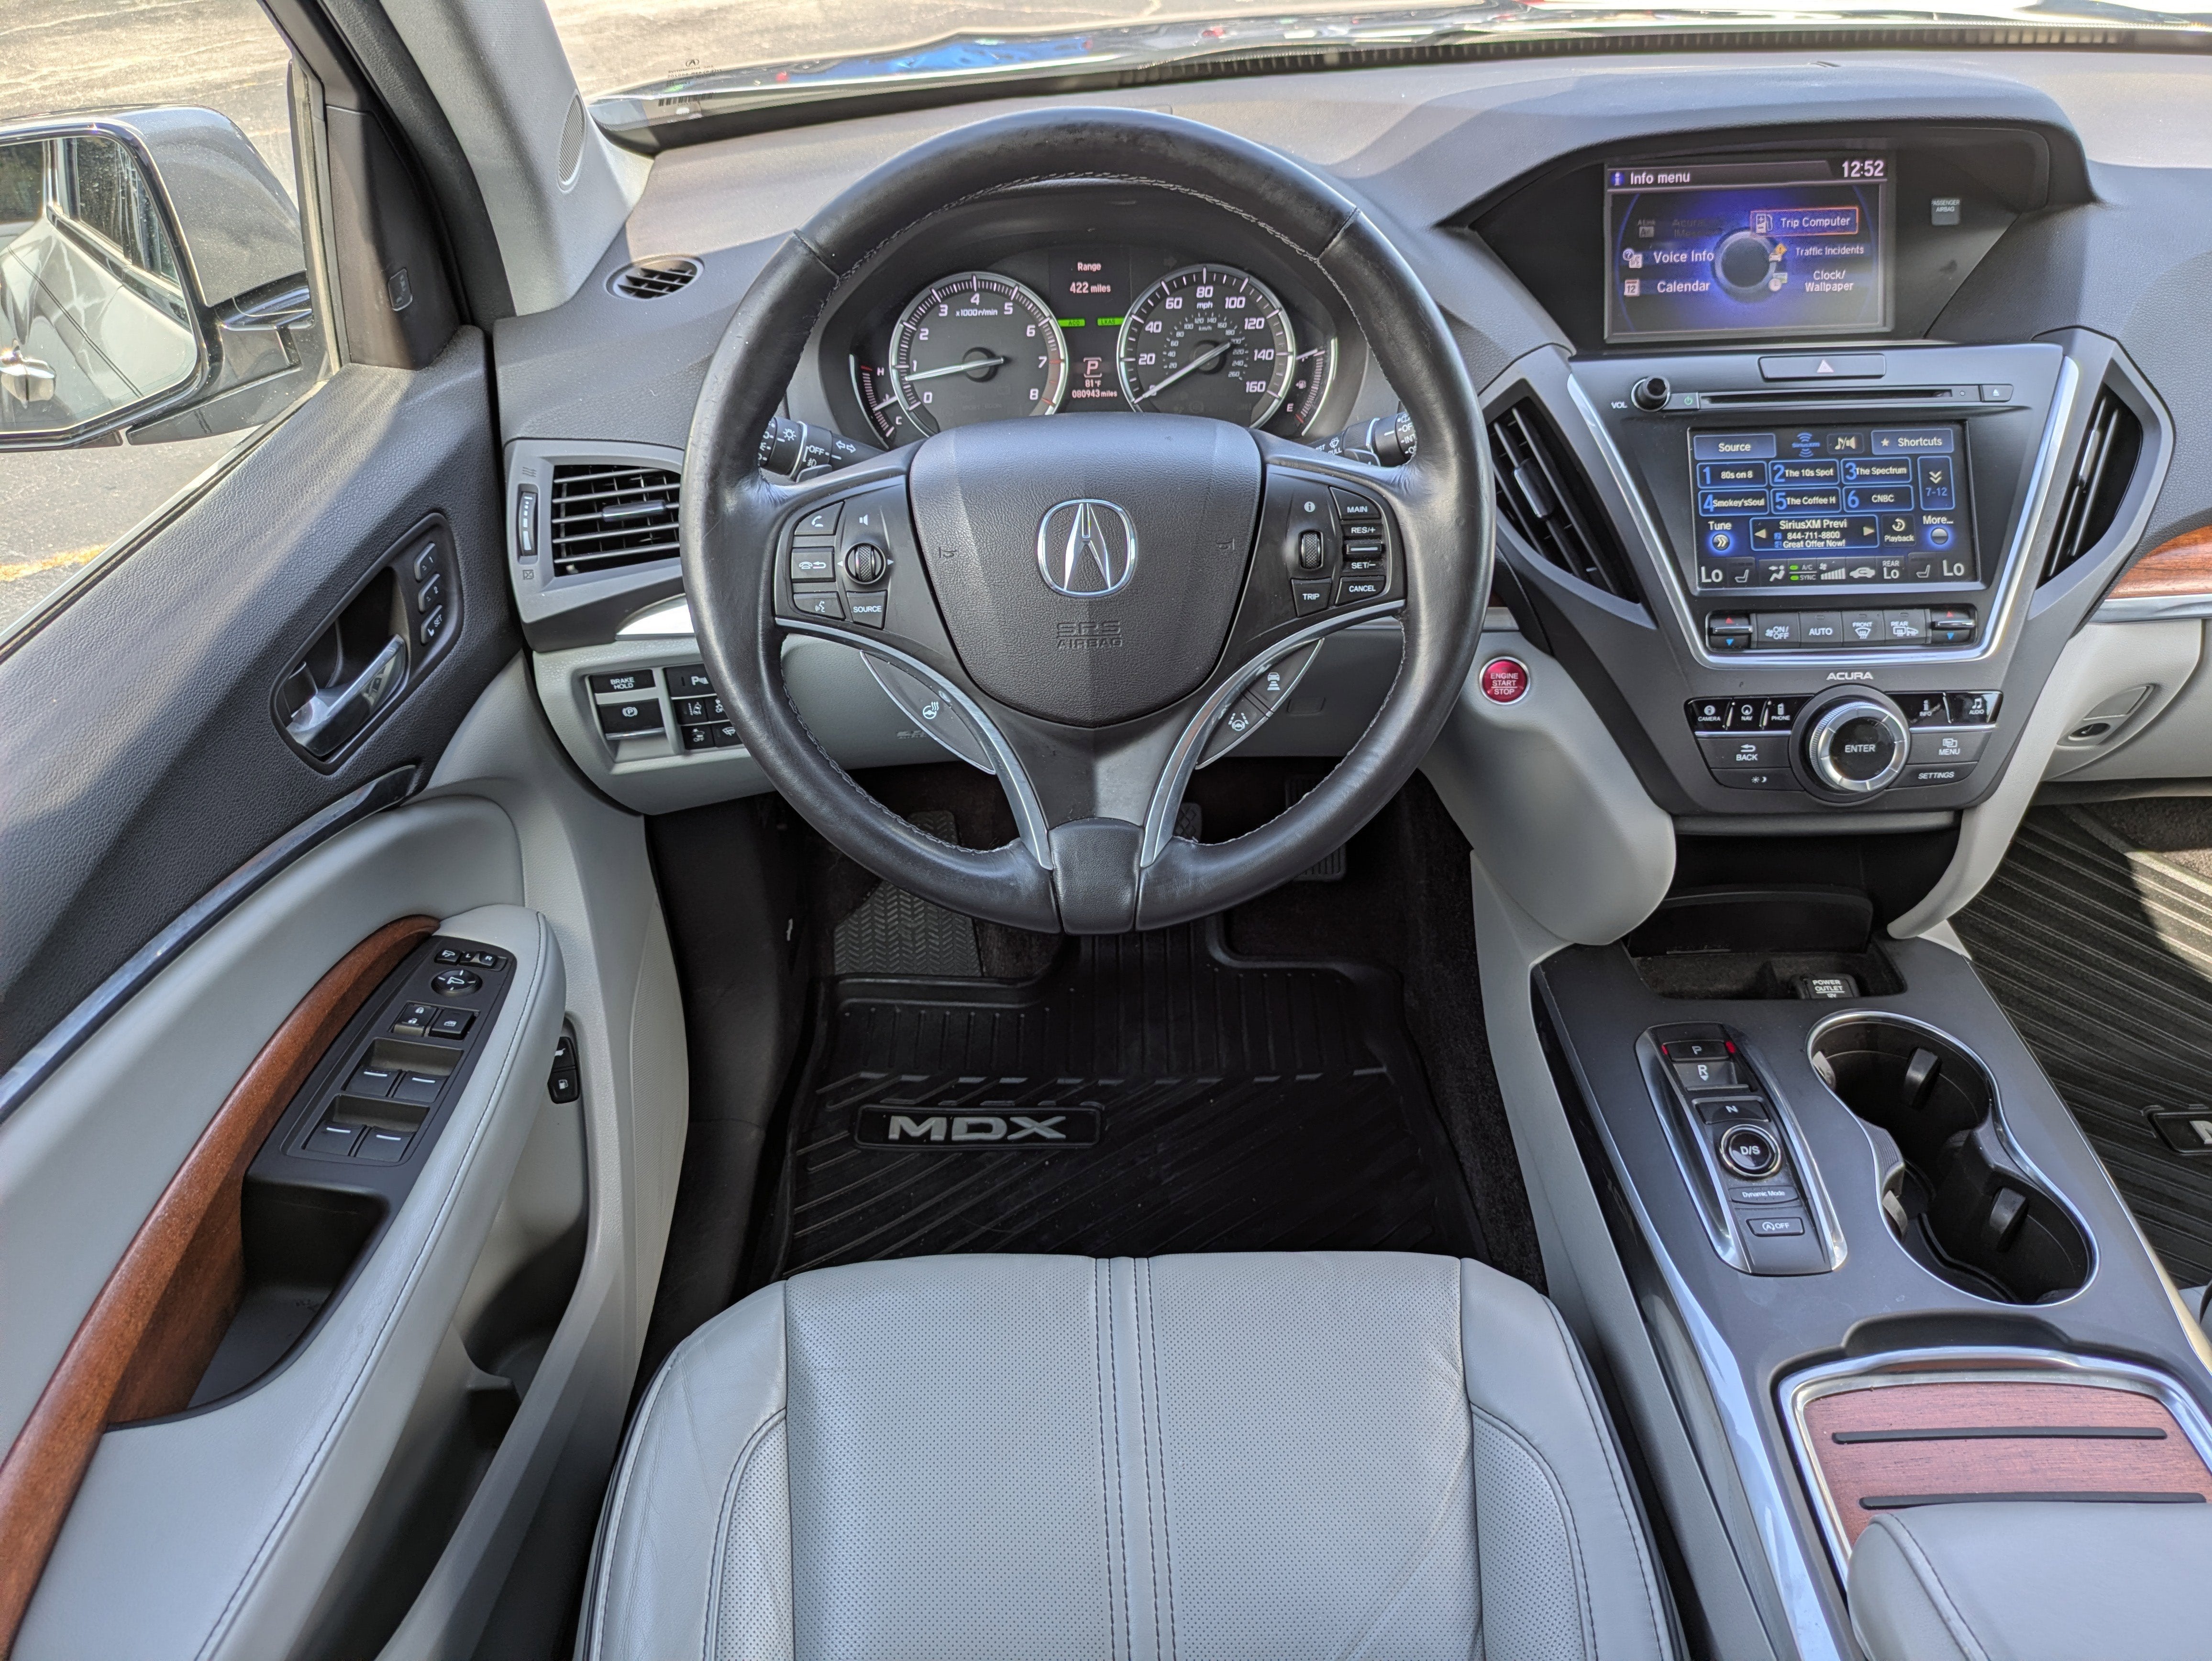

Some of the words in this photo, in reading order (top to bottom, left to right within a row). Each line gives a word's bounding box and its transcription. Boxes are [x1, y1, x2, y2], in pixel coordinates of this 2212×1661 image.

[1842, 159, 1884, 177] 12:52
[1630, 172, 1654, 185] Info
[1658, 172, 1691, 184] menu
[1780, 217, 1799, 228] Trip
[1802, 216, 1851, 228] Computer
[1795, 246, 1823, 256] Traffic
[1825, 245, 1864, 255] Incidents
[1653, 251, 1687, 264] Voice
[1691, 250, 1715, 262] Info
[1077, 261, 1101, 272] Range
[1813, 268, 1846, 281] Clock/
[1069, 281, 1089, 294] 422
[1090, 284, 1111, 293] miles
[1196, 286, 1214, 298] 80
[1627, 285, 1636, 294] 12
[1657, 280, 1711, 293] Calendar
[1804, 281, 1854, 292] Wallpaper
[971, 293, 980, 305] 4
[1166, 297, 1183, 309] 60
[1225, 297, 1246, 309] 100
[939, 304, 948, 316] 3
[1004, 302, 1013, 315] 5
[1196, 301, 1213, 310] mph
[1145, 321, 1162, 333] 40
[1244, 317, 1264, 330] 120
[919, 328, 929, 341] 2
[1026, 324, 1036, 337] 6
[1139, 353, 1155, 365] 20
[1253, 349, 1274, 361] 140
[912, 359, 917, 372] 1
[1038, 356, 1047, 368] 7
[1086, 360, 1099, 375] P
[876, 367, 885, 376] H
[1246, 381, 1266, 393] 160
[923, 391, 932, 404] 0
[1029, 388, 1039, 400] 8
[1071, 389, 1100, 399] 080943
[1286, 403, 1294, 412] E
[895, 416, 902, 425] C
[1401, 422, 1413, 431] OF
[1718, 442, 1751, 453] Source
[1897, 436, 1943, 447] Shortcuts
[808, 444, 825, 455] OFF
[1703, 466, 1712, 485] 1
[1721, 471, 1735, 480] 80s
[1736, 471, 1747, 479] on
[1747, 470, 1754, 479] 8
[1773, 464, 1786, 483] 2
[1785, 469, 1800, 477] The
[1801, 468, 1814, 477] 10s
[1815, 467, 1834, 477] Spot
[1845, 462, 1858, 481] 3
[1856, 467, 1870, 476] The
[1871, 466, 1907, 476] Spectrum
[1925, 487, 1948, 497] 7-12
[1703, 494, 1714, 512] 4
[1775, 492, 1787, 510] 5
[1786, 497, 1801, 505] The
[1802, 497, 1828, 505] Coffee
[1847, 489, 1859, 508] 6
[1871, 494, 1895, 503] CNBC
[1707, 520, 1733, 531] Tune
[1779, 519, 1821, 531] SiriusXM
[1823, 517, 1848, 529] Previ
[1787, 531, 1841, 540] 844-711-8800
[1884, 534, 1914, 543] Playback
[1782, 540, 1804, 549] Great
[1805, 539, 1825, 549] Offer
[1882, 567, 1900, 579] Lo
[1942, 559, 1965, 576] Lo
[1701, 566, 1723, 583] Lo
[433, 586, 439, 594] 2
[852, 605, 882, 614] SOURCE
[1808, 627, 1834, 636] AUTO
[1057, 638, 1123, 649] AIRBAG
[609, 676, 635, 685] BRAKE
[1826, 671, 1874, 681] ACURA
[1845, 743, 1876, 753] ENTER
[1938, 747, 1961, 756] MENU
[1736, 753, 1759, 762] BACK
[1917, 771, 1955, 780] SETTINGS
[1692, 1045, 1703, 1055] P
[1698, 1064, 1709, 1076] R
[1725, 1105, 1739, 1114] N
[888, 1115, 1067, 1141] MDX
[1740, 1145, 1761, 1156] D/S
